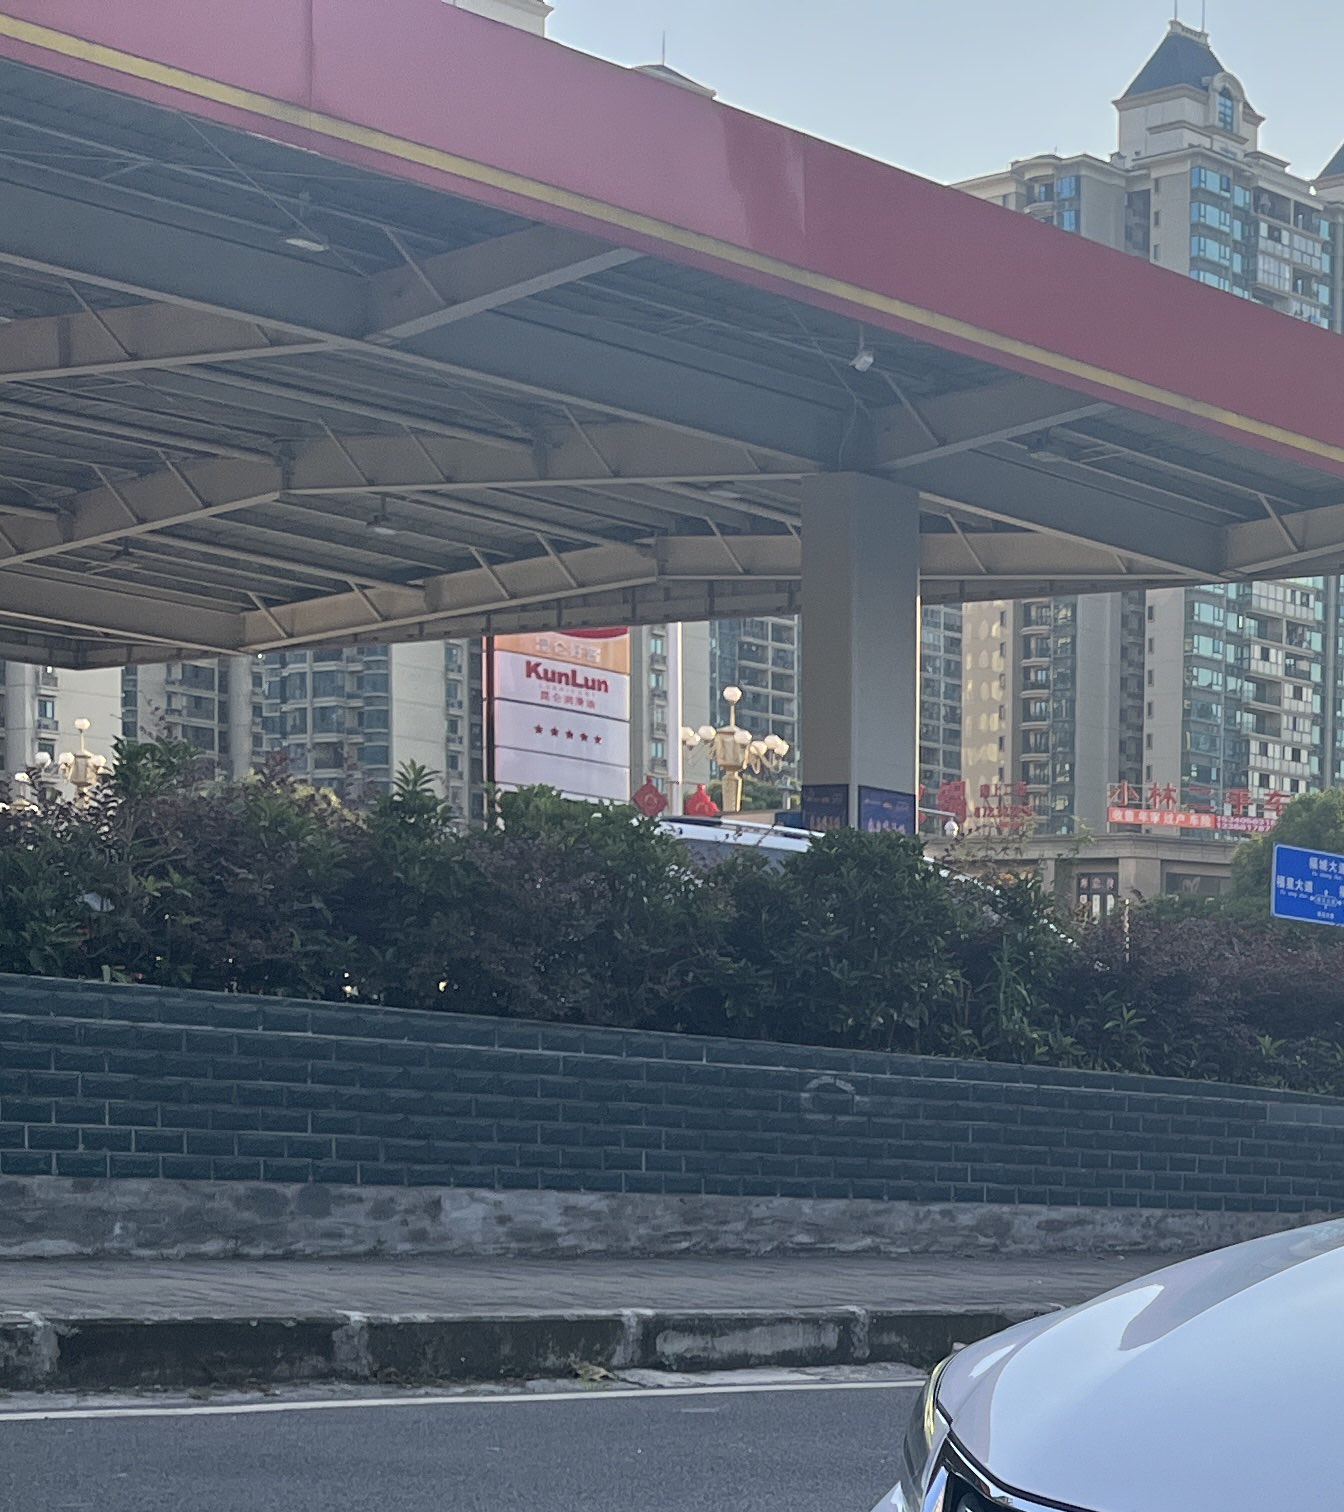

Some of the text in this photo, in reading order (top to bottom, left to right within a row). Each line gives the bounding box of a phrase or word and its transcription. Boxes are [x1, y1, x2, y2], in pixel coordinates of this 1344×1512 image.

[525, 660, 609, 694] KunLun
[1109, 780, 1292, 817] 小林二手车
